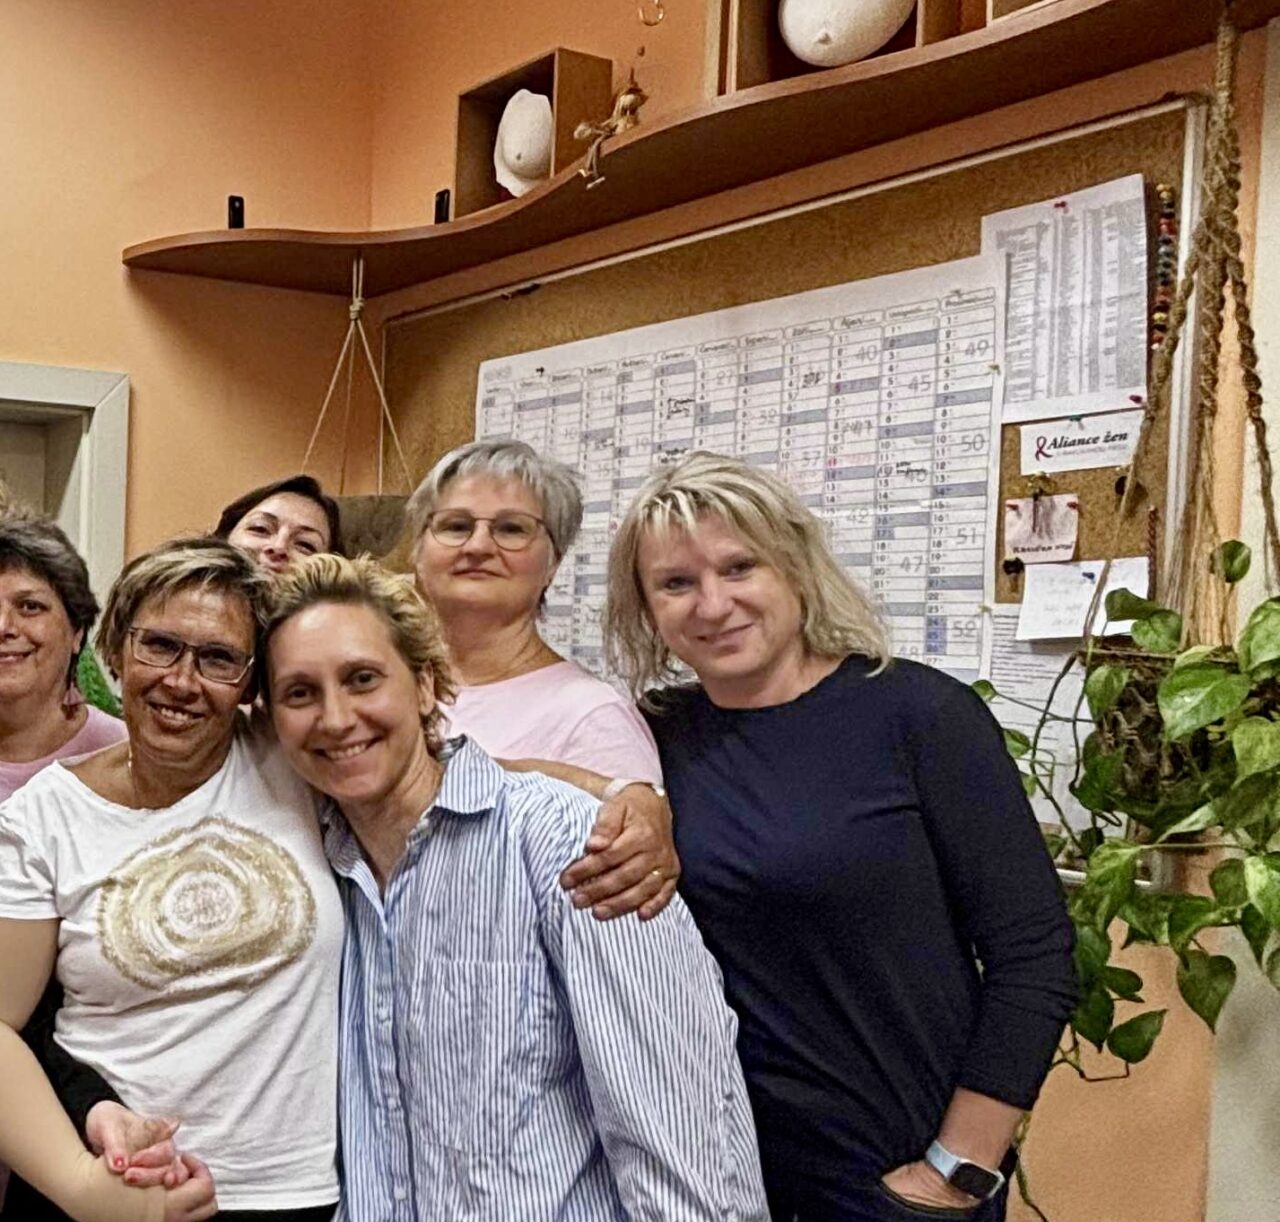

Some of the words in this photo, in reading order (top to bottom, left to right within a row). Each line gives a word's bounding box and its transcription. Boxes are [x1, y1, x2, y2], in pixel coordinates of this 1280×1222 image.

[961, 433, 985, 451] 50
[1047, 435, 1101, 450] Aliance
[1102, 430, 1128, 443] žen
